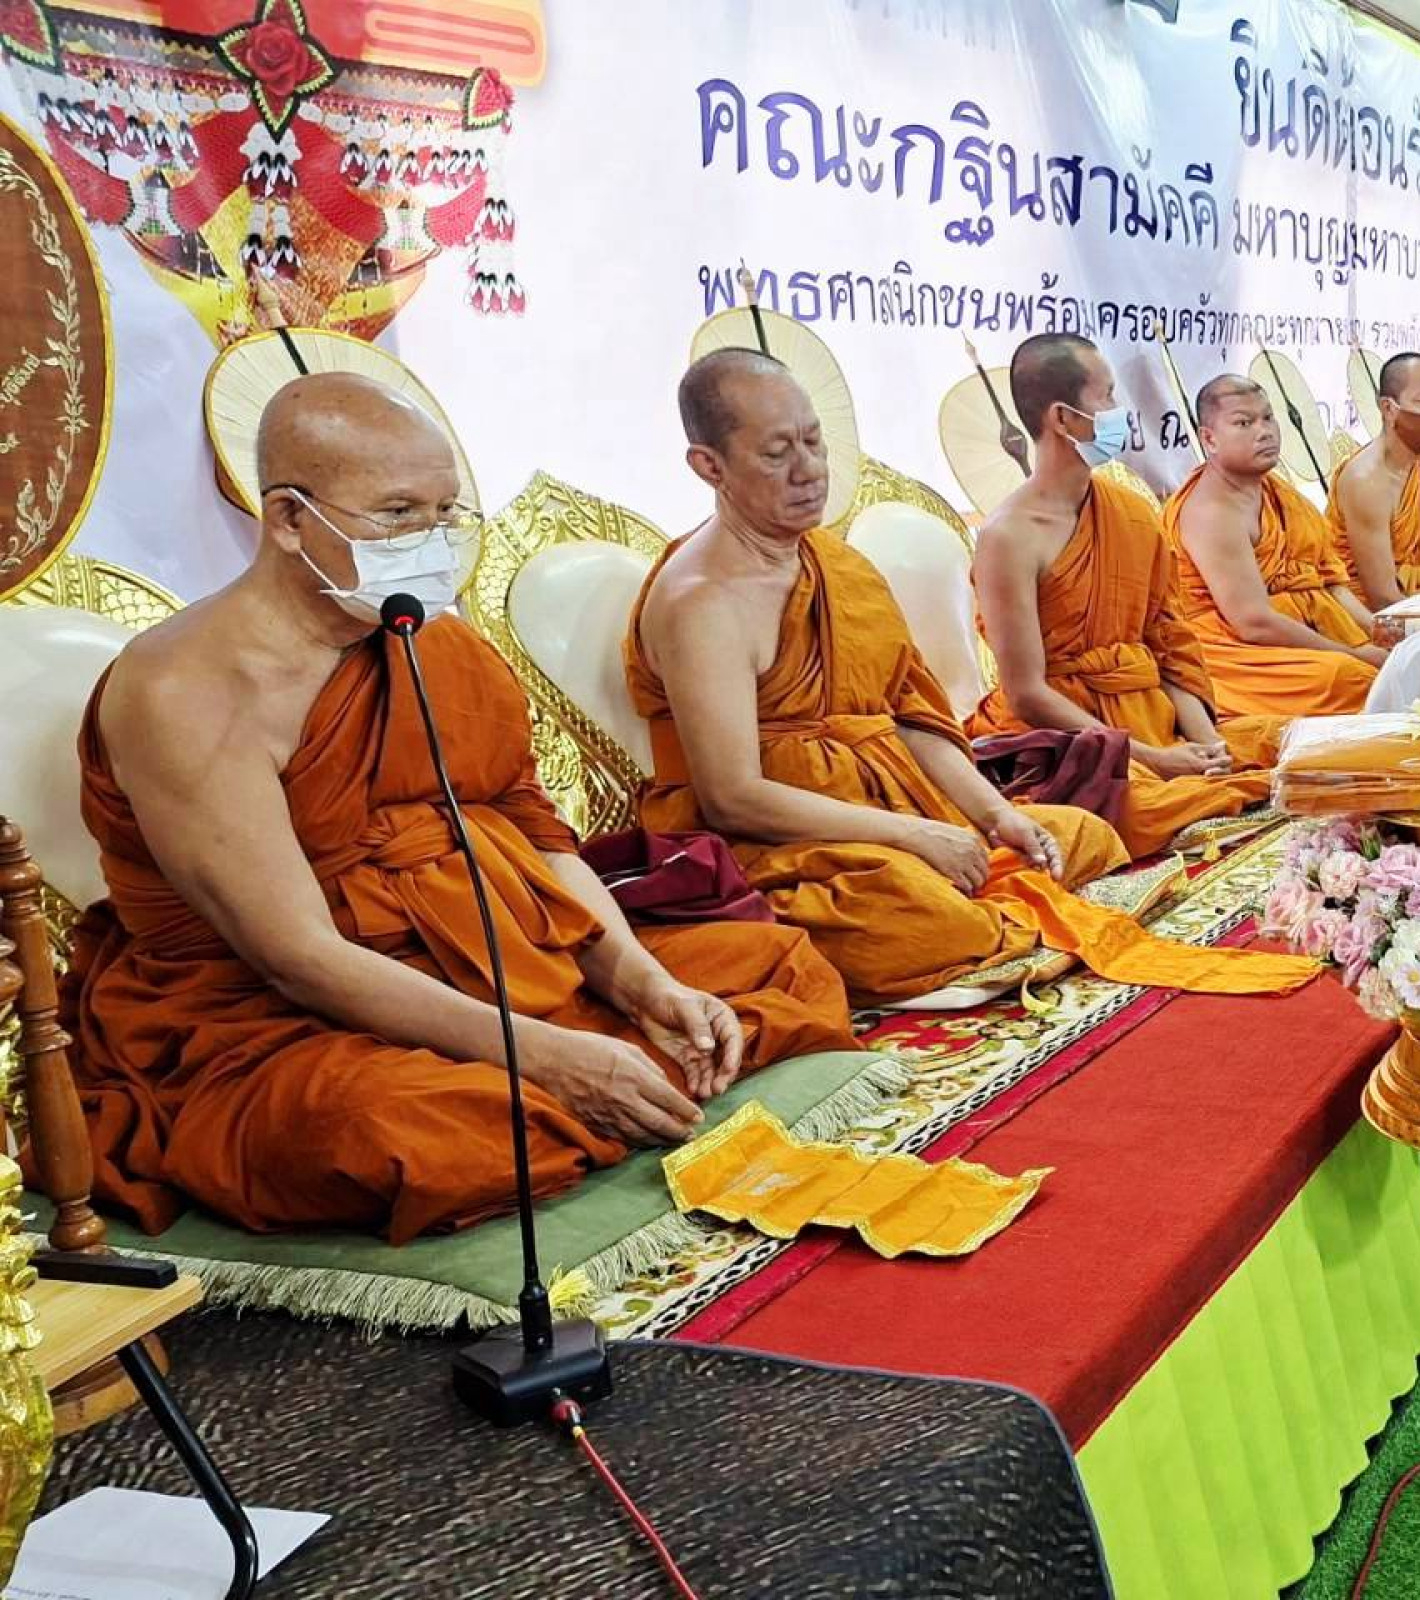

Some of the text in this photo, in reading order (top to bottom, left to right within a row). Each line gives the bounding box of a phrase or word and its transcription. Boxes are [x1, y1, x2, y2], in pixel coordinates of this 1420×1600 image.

[695, 77, 1220, 248] คณะกฐินสามัคคี
